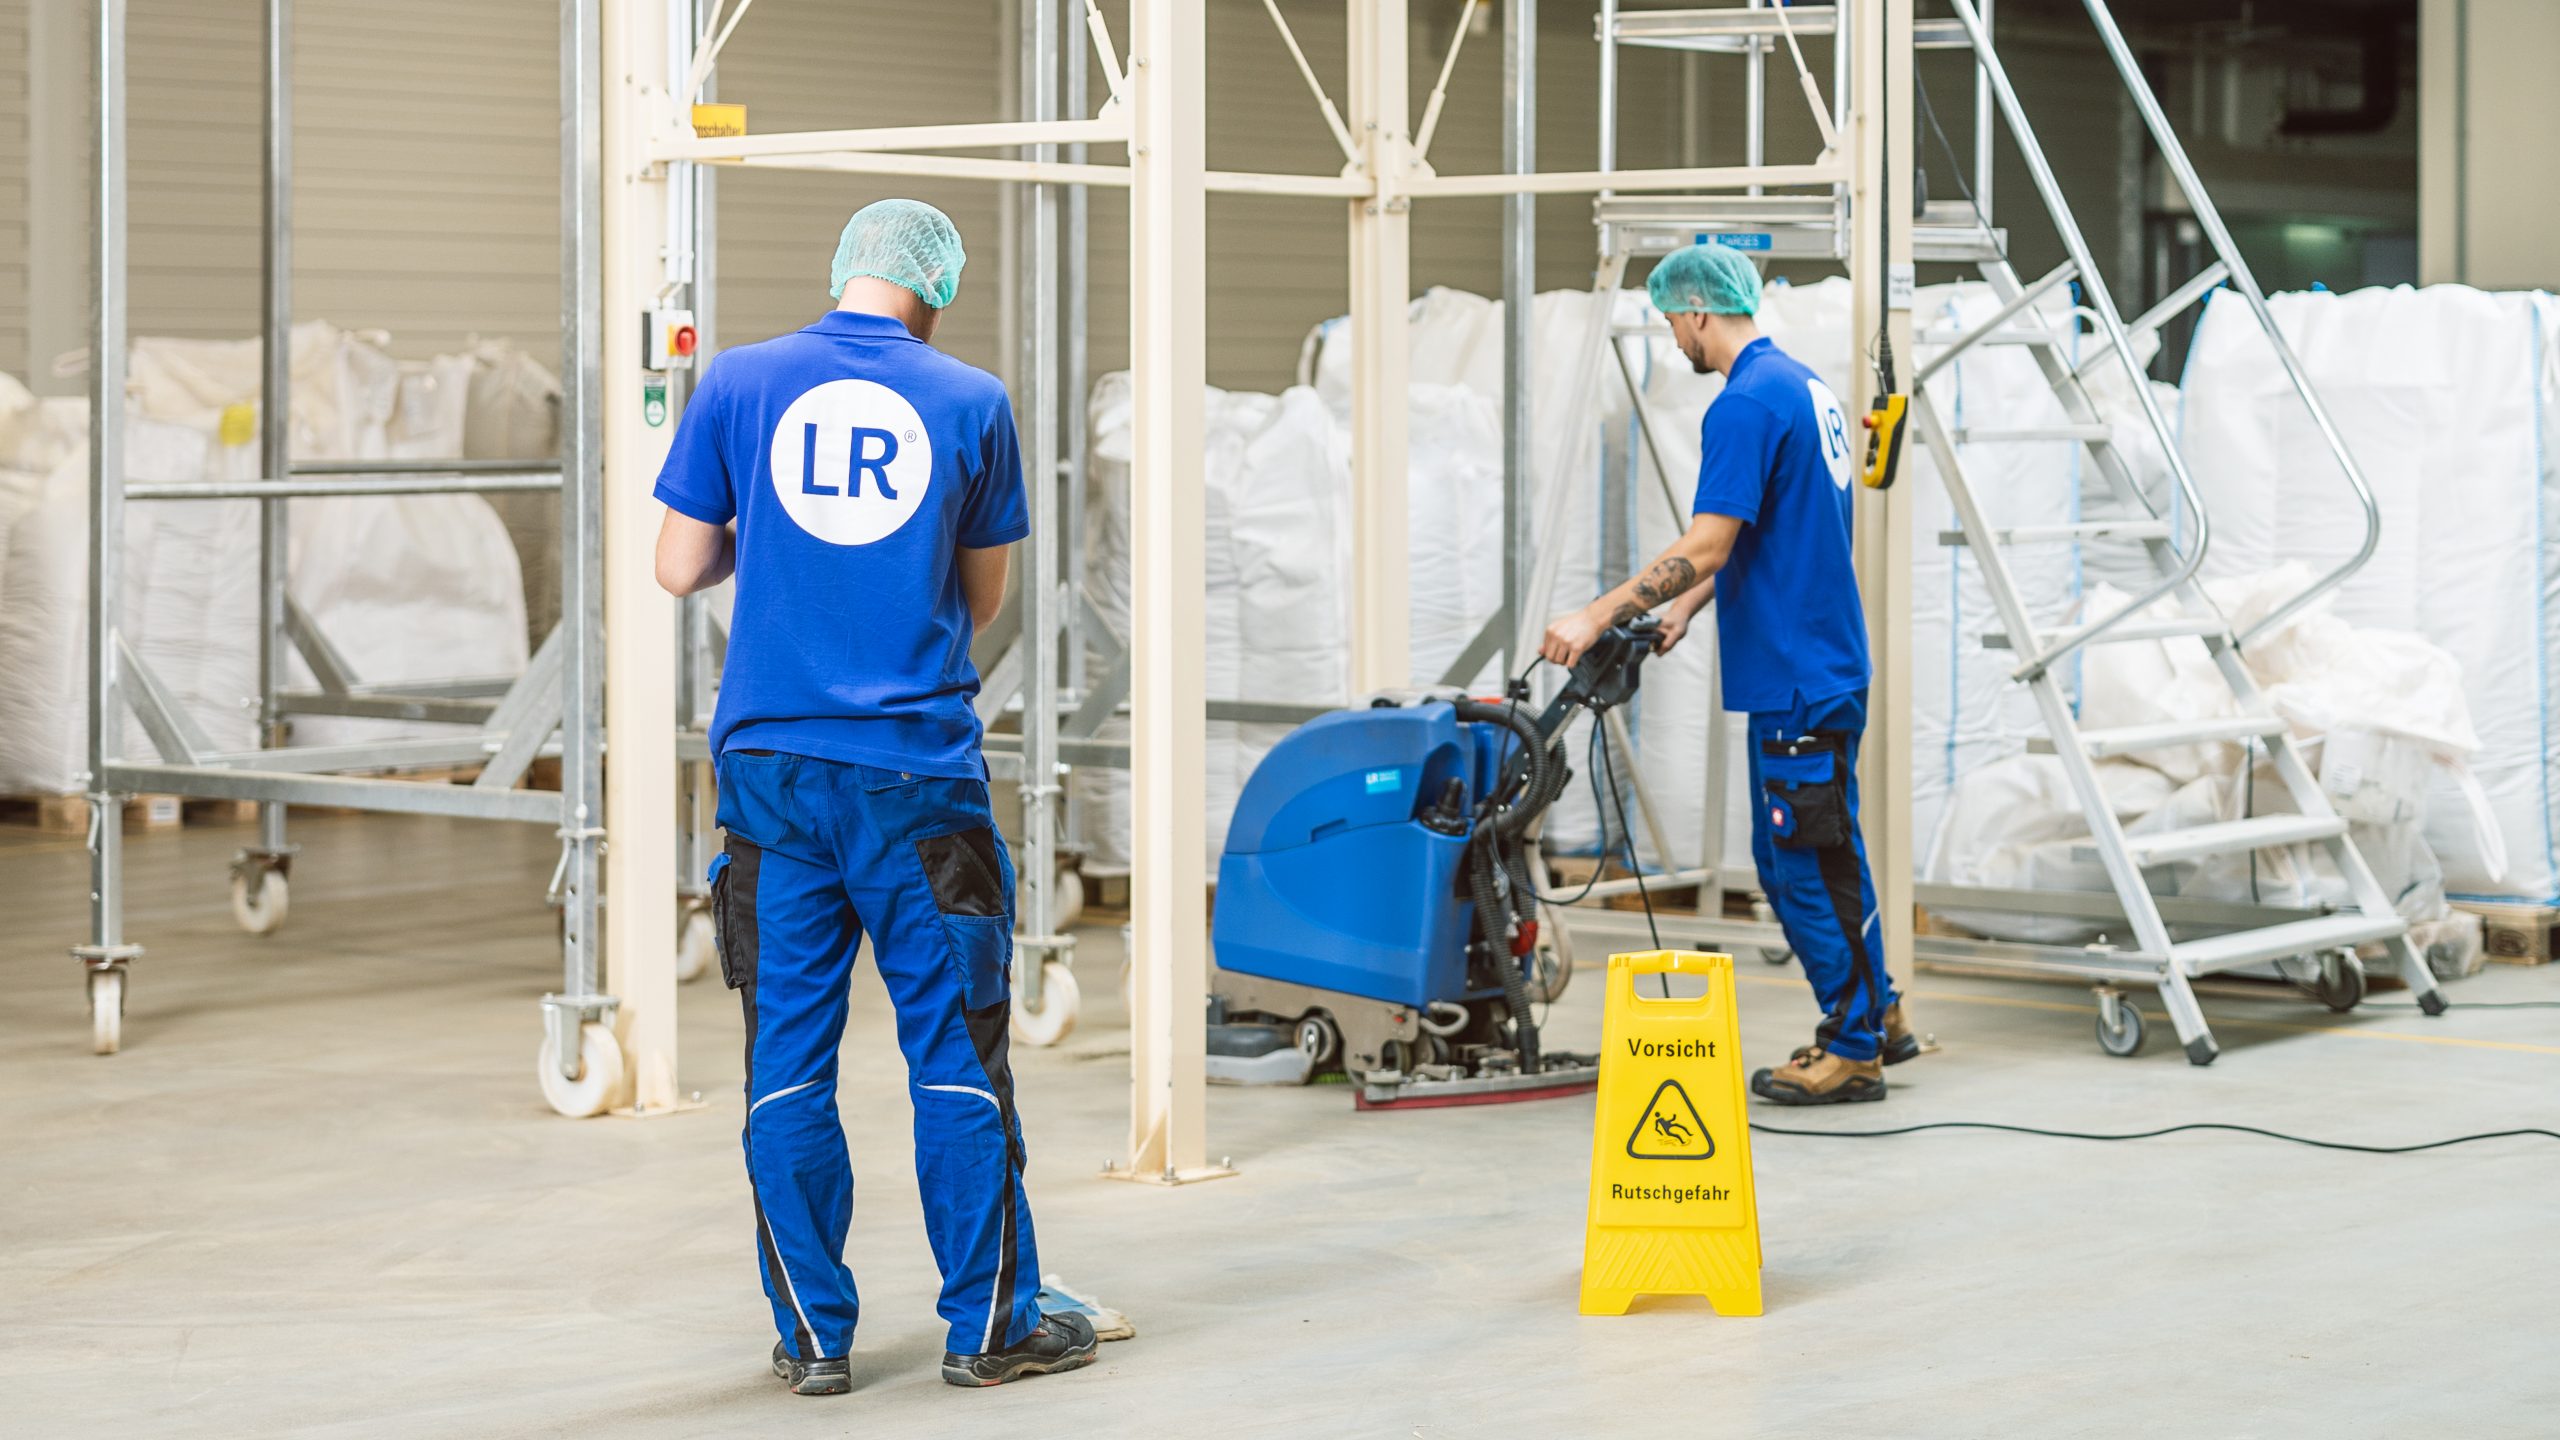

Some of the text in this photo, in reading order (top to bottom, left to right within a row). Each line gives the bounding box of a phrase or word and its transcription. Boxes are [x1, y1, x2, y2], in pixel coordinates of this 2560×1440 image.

[1823, 408, 1850, 459] LR
[1628, 1038, 1716, 1058] Vorsicht
[1612, 1183, 1730, 1204] Rutschgefahr
